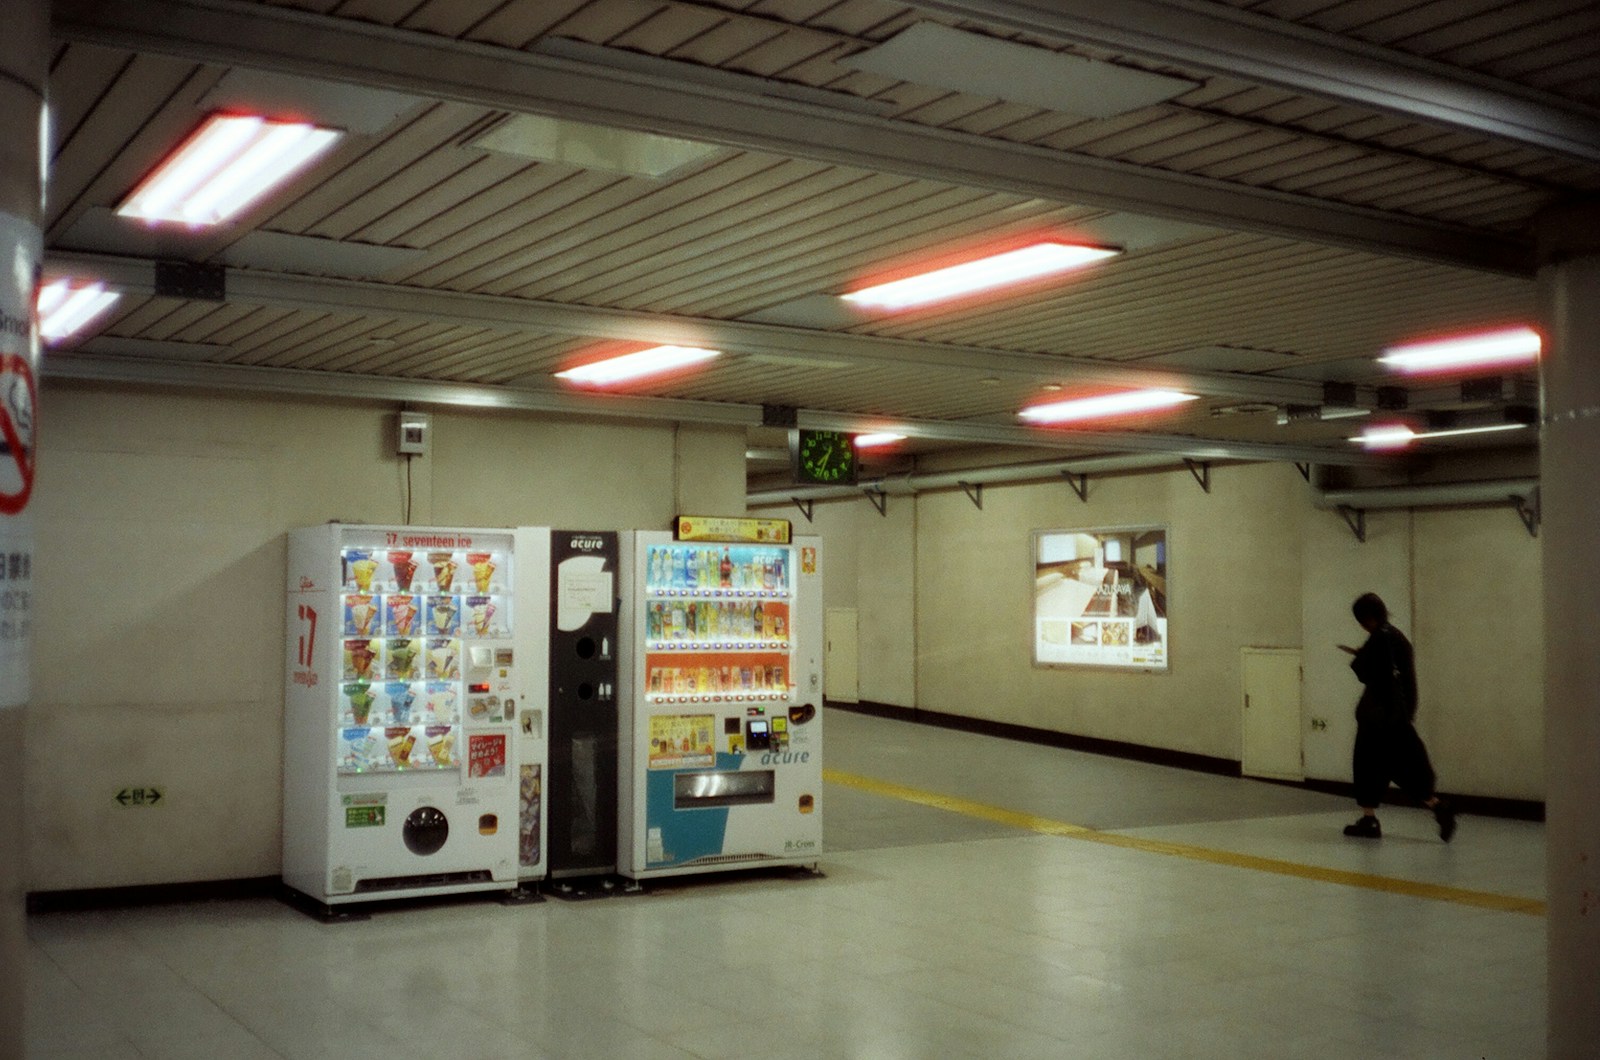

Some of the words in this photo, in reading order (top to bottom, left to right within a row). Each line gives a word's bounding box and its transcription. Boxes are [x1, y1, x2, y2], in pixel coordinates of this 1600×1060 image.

[403, 535, 454, 547] seventeen
[458, 533, 472, 547] ice
[571, 539, 603, 550] acure
[761, 752, 810, 766] acure
